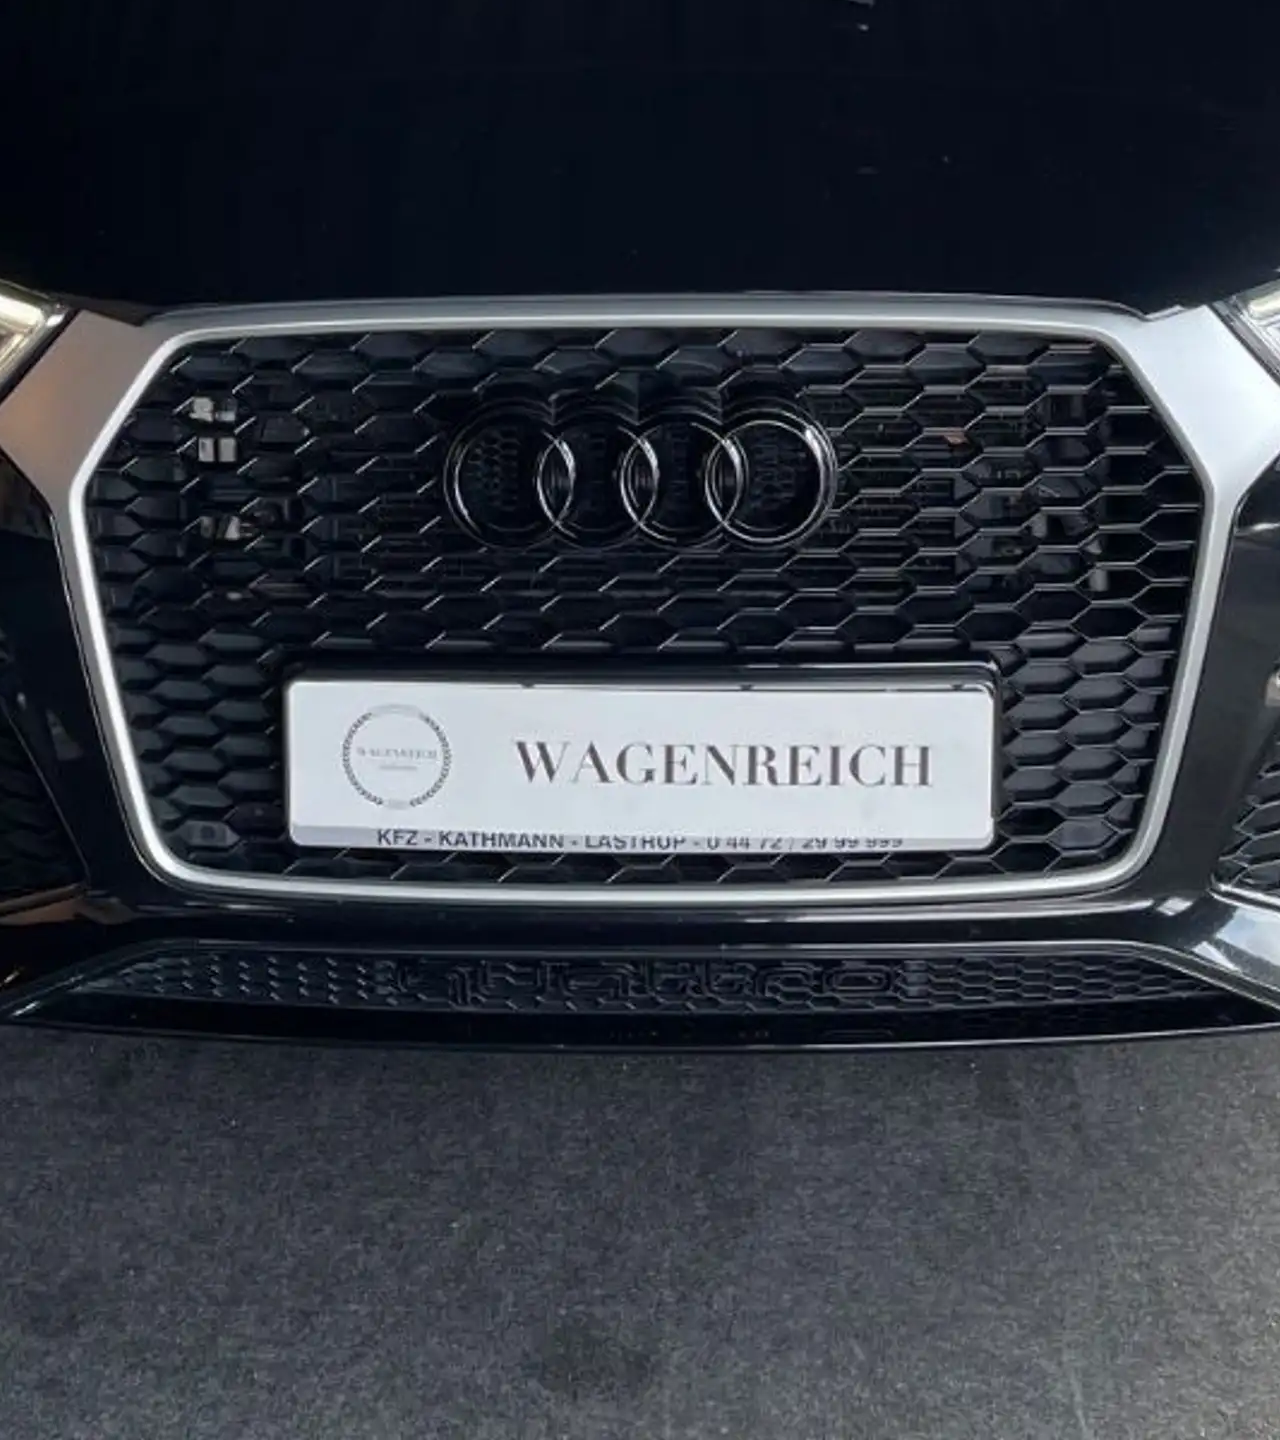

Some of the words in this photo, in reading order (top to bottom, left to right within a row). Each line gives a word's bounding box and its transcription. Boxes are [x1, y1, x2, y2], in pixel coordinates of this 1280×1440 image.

[516, 740, 934, 788] WAGENREICH
[376, 828, 419, 847] KFZ
[438, 829, 565, 849] KATHMANN
[584, 834, 687, 851] LASTRUP
